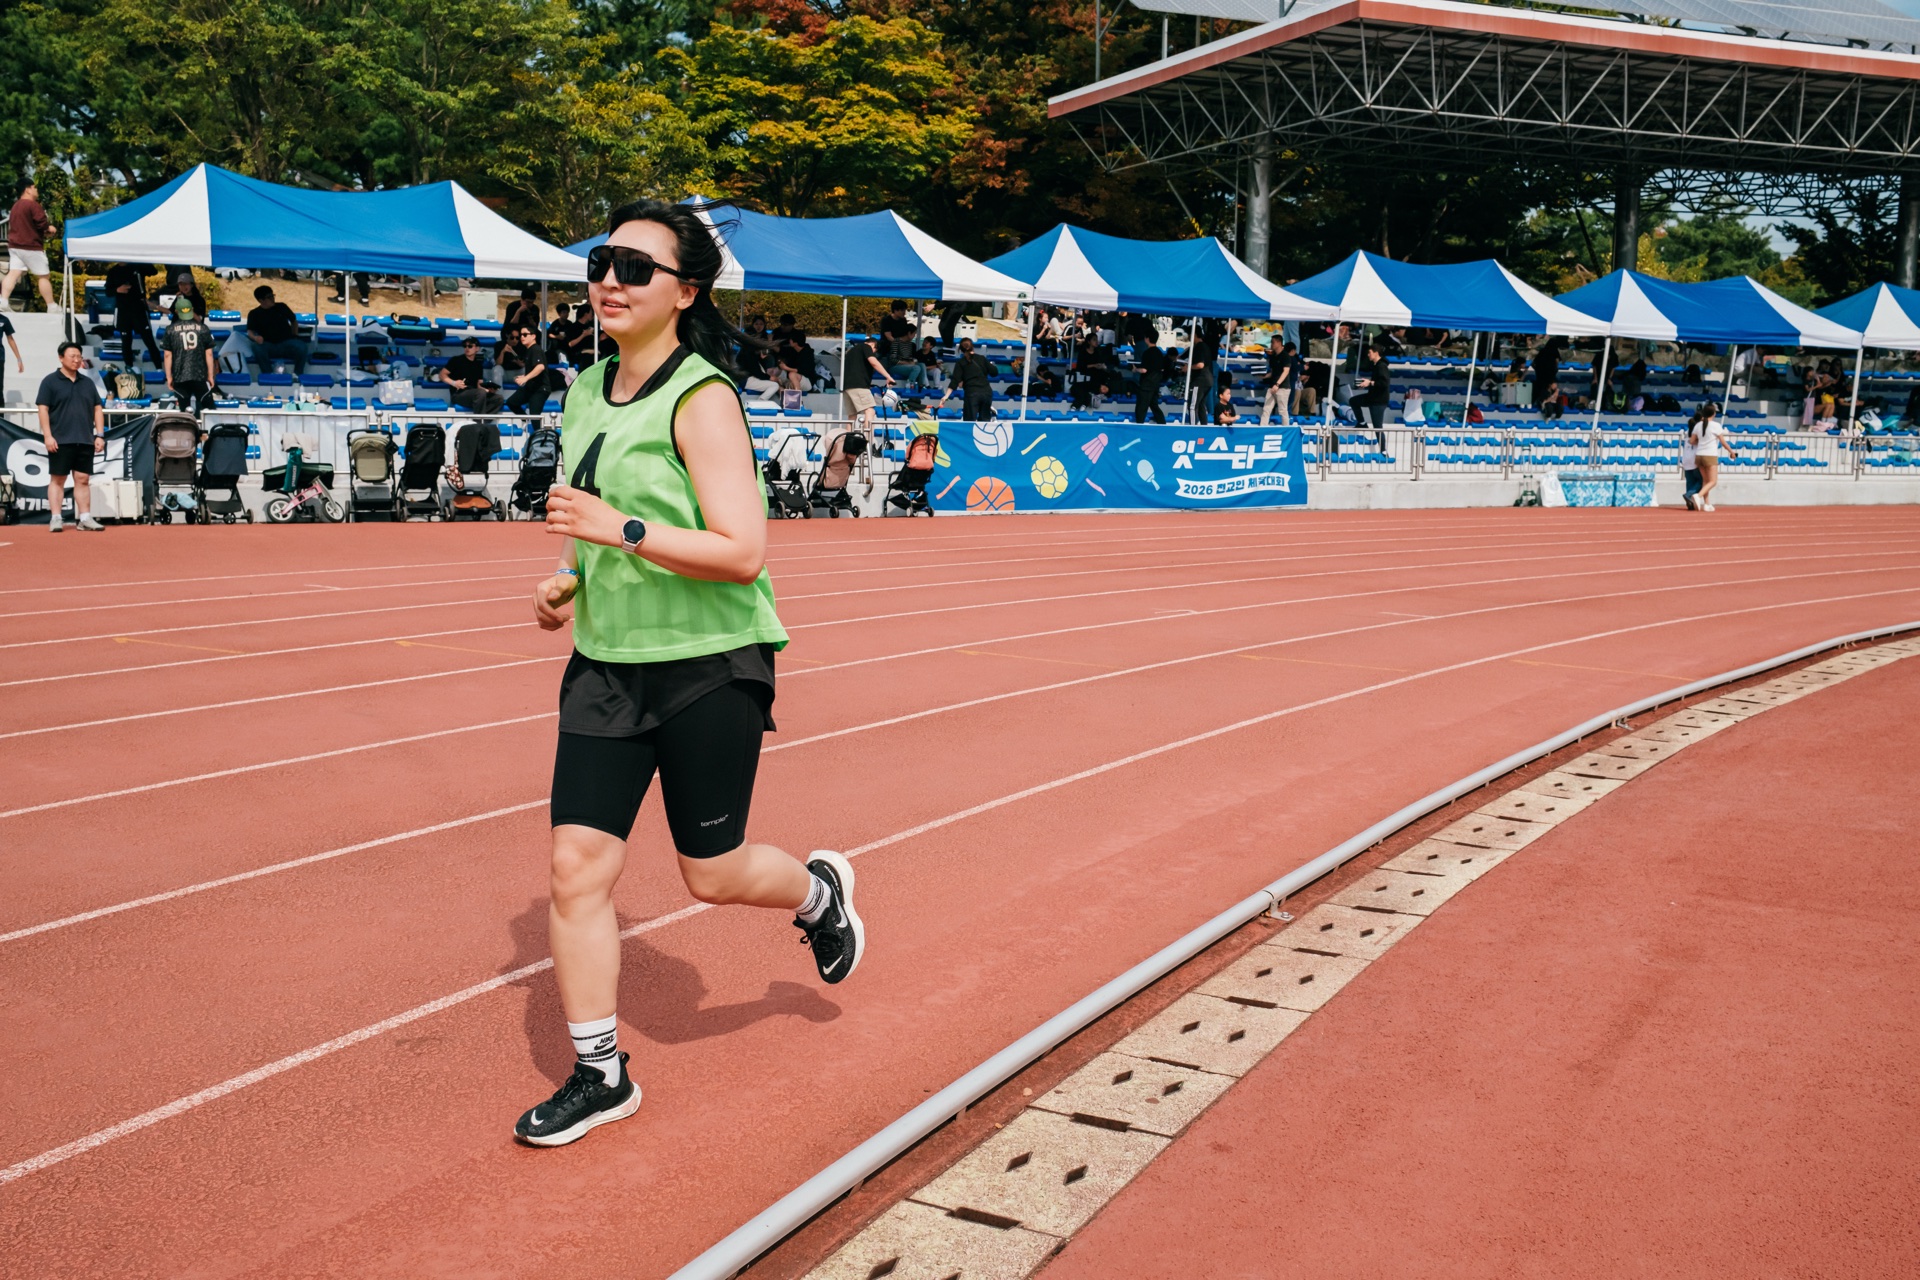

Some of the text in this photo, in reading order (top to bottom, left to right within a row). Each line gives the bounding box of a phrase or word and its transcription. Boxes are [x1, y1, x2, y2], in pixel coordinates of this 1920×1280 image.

[180, 331, 198, 350] 19
[570, 432, 607, 499] 4
[1183, 475, 1285, 495] 2026 전교인 체육대회
[599, 1033, 616, 1045] NIKE
